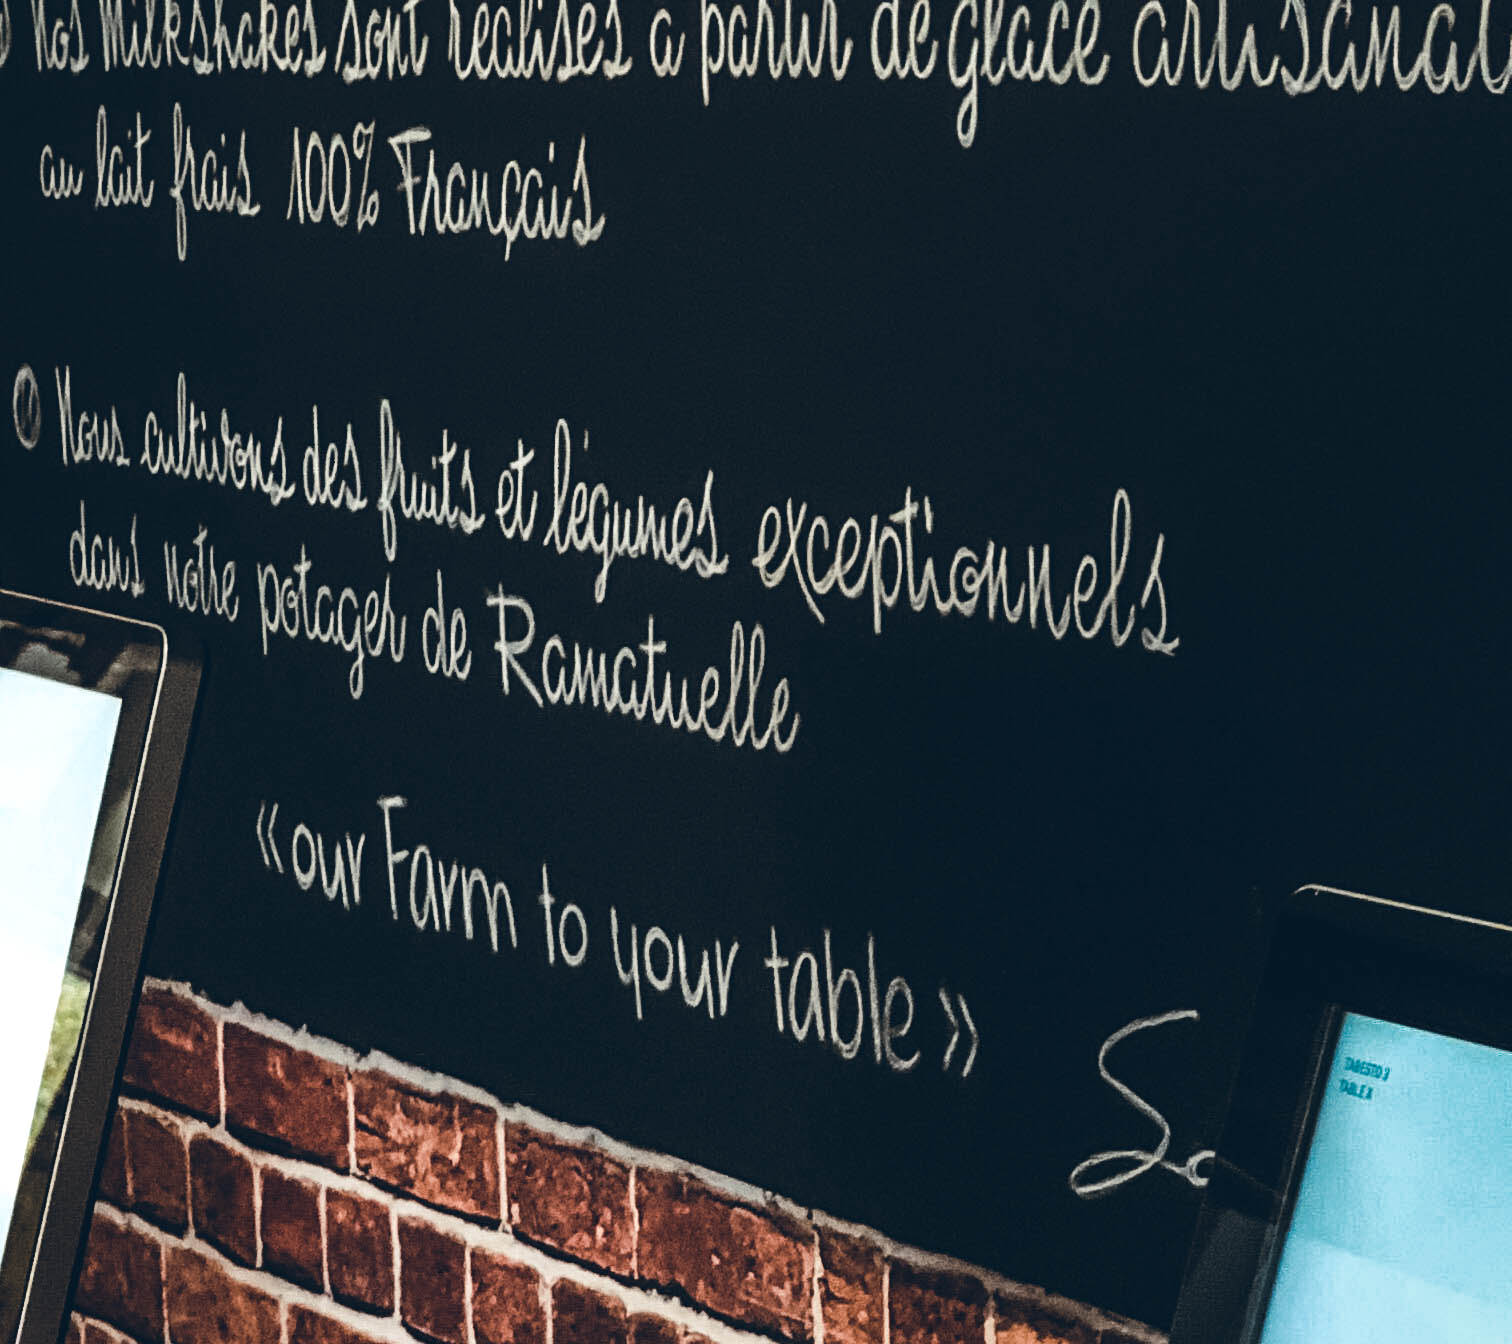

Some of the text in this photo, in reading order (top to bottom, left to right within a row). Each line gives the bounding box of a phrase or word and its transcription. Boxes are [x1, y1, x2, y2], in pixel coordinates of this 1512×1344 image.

[30, 0, 90, 74] Nos
[333, 0, 430, 85] sont
[700, 0, 854, 107] partir
[39, 101, 606, 262] au lait frais 100% Français
[54, 365, 1180, 657] Nous cultivons des fruits et légumes exceptionnels
[69, 499, 801, 753] dans notre potager de Ramatuelle
[376, 795, 518, 953] Farm
[538, 863, 589, 968] to
[609, 905, 740, 1021] your
